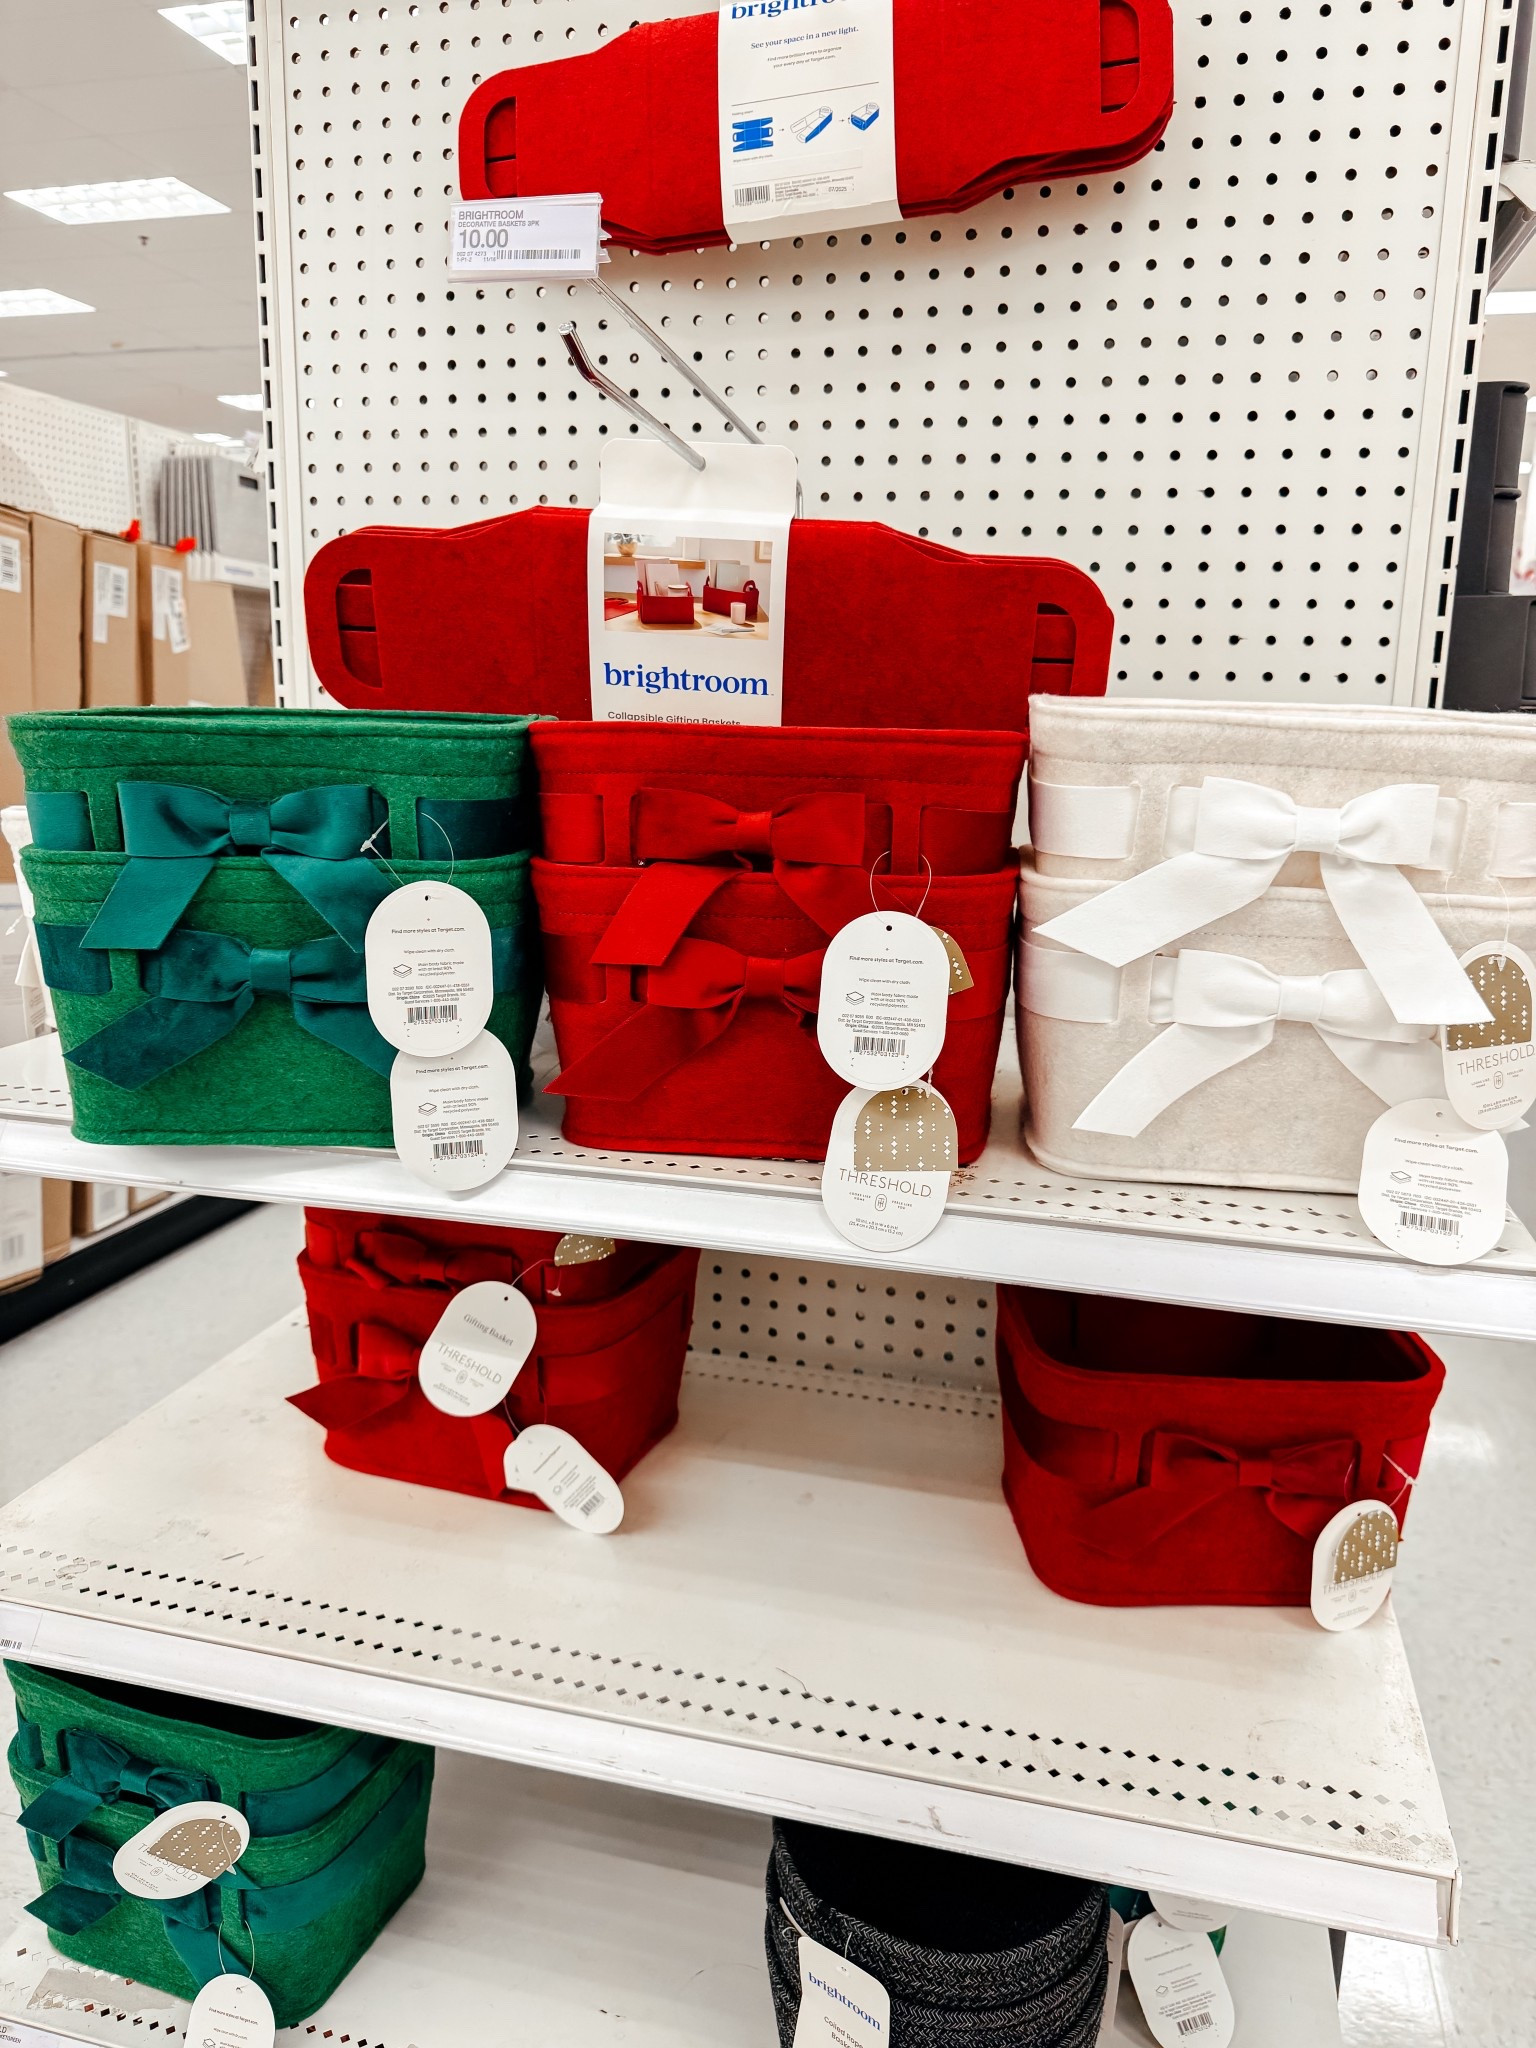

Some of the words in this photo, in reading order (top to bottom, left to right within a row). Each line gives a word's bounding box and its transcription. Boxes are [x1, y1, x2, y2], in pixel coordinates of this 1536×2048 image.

[765, 39, 782, 48] your
[784, 36, 804, 44] space
[839, 26, 859, 35] light.
[459, 210, 523, 220] BRIGHTROOM
[459, 229, 508, 248] 10.00
[603, 662, 769, 696] brightroom
[608, 711, 663, 723] Collapsible
[1457, 1044, 1535, 1075] THRESHOLD
[840, 1168, 931, 1197] THRESHOLD
[464, 1313, 489, 1334] Gifting
[489, 1328, 514, 1346] Basket
[438, 1342, 502, 1384] THRESHOLD
[809, 1972, 880, 2031] brightroom
[824, 2016, 845, 2036] Coiled
